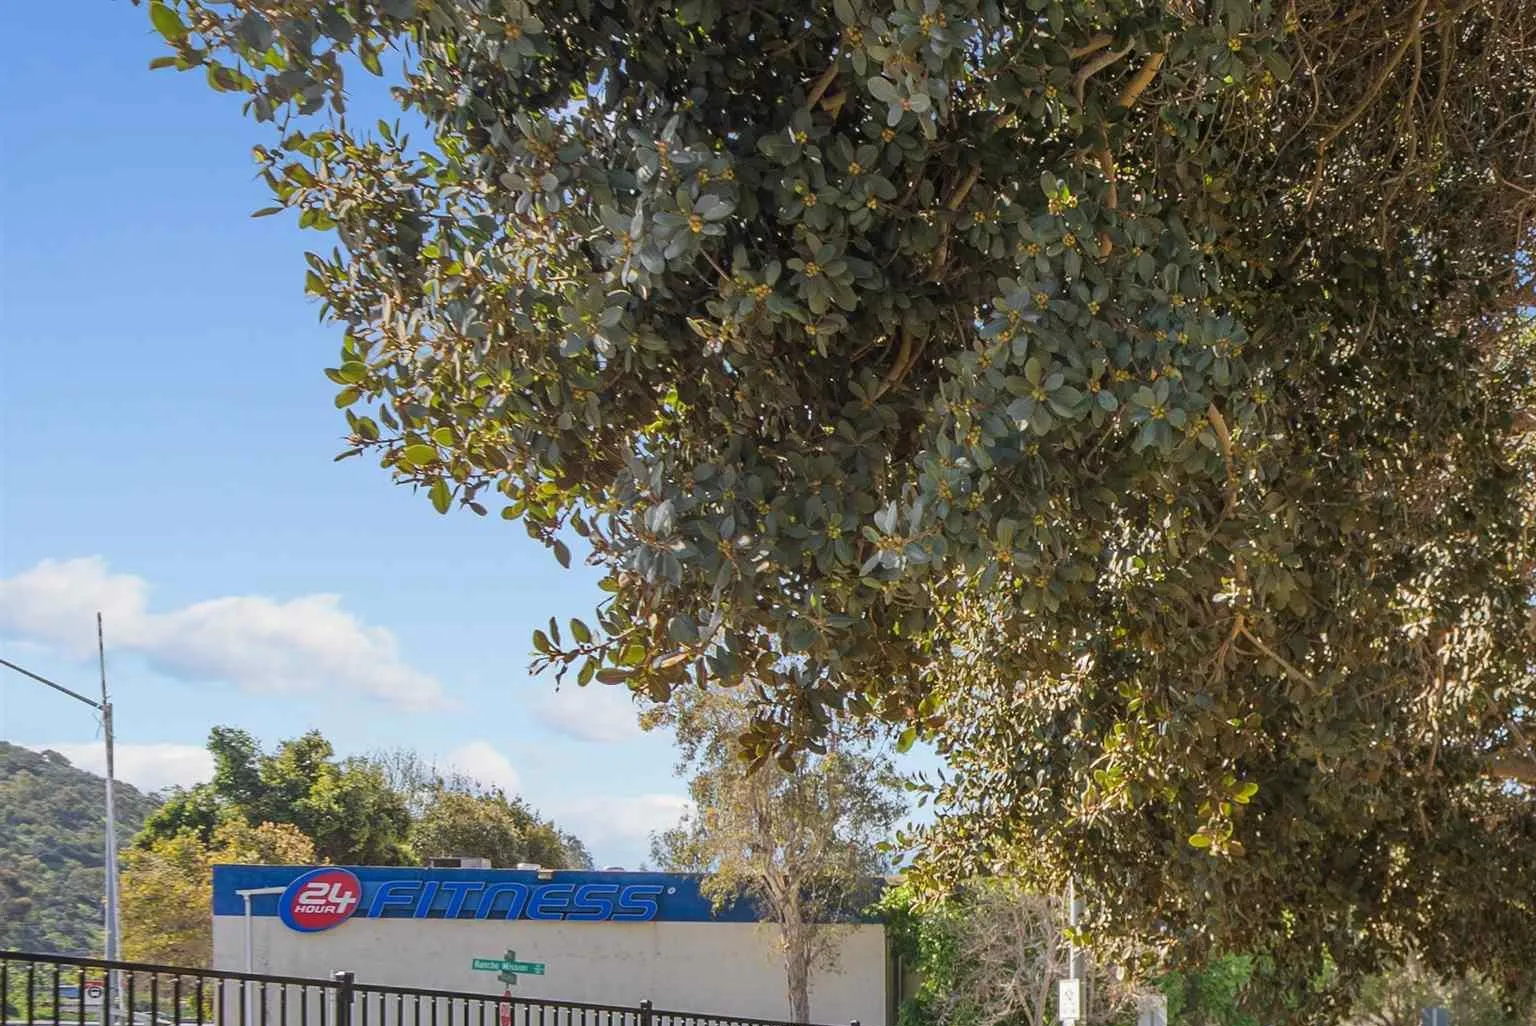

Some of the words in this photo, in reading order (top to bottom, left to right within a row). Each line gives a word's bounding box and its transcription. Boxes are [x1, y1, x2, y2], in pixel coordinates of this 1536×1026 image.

[295, 904, 337, 914] HOUR
[299, 882, 356, 914] 24
[366, 880, 664, 921] FITNESS
